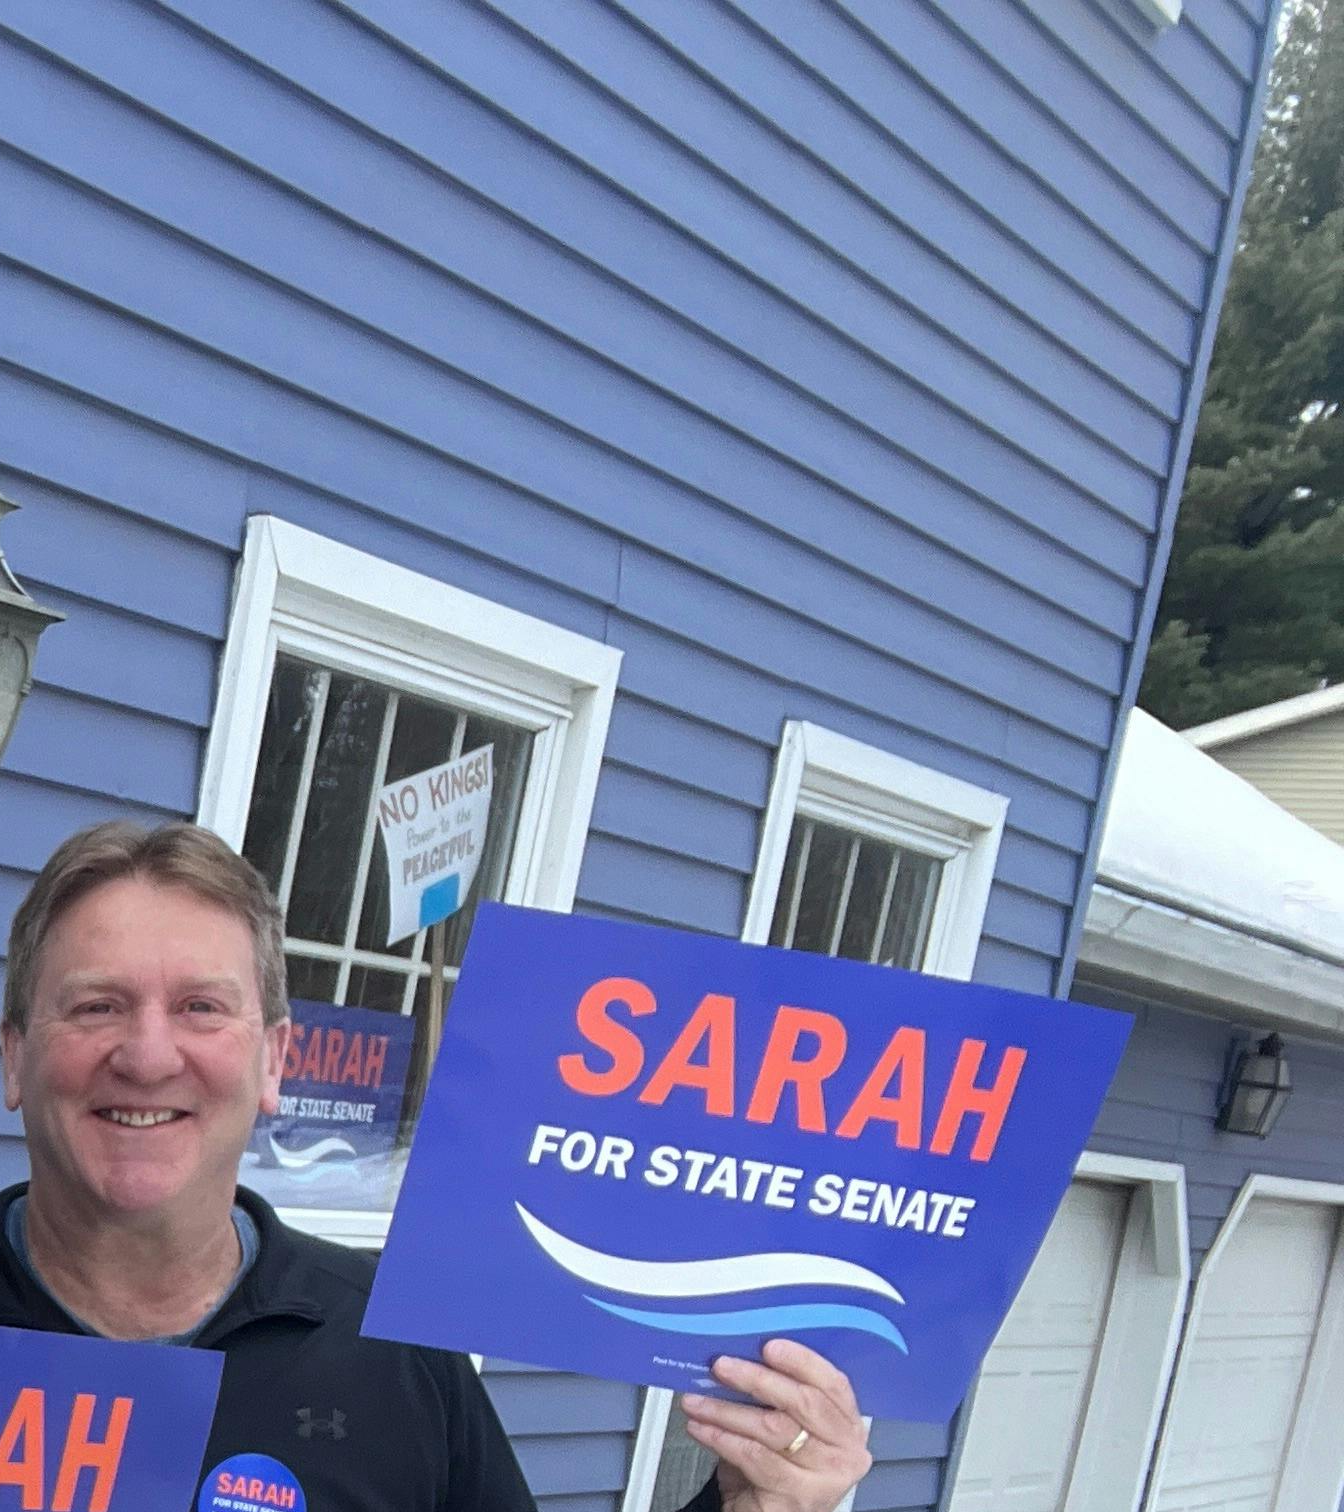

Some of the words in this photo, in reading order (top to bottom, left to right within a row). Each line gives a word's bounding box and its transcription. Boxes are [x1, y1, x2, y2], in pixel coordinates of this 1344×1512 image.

[379, 784, 419, 828] NO
[282, 1023, 390, 1089] SARAH
[558, 977, 1027, 1162] SARAH
[298, 1098, 332, 1119] STATE
[332, 1101, 376, 1123] SENATE
[528, 1124, 635, 1179] FOR
[644, 1145, 804, 1209] STATE
[808, 1174, 977, 1238] SENATE
[213, 1496, 232, 1508] FOR
[217, 1472, 296, 1509] SARAH
